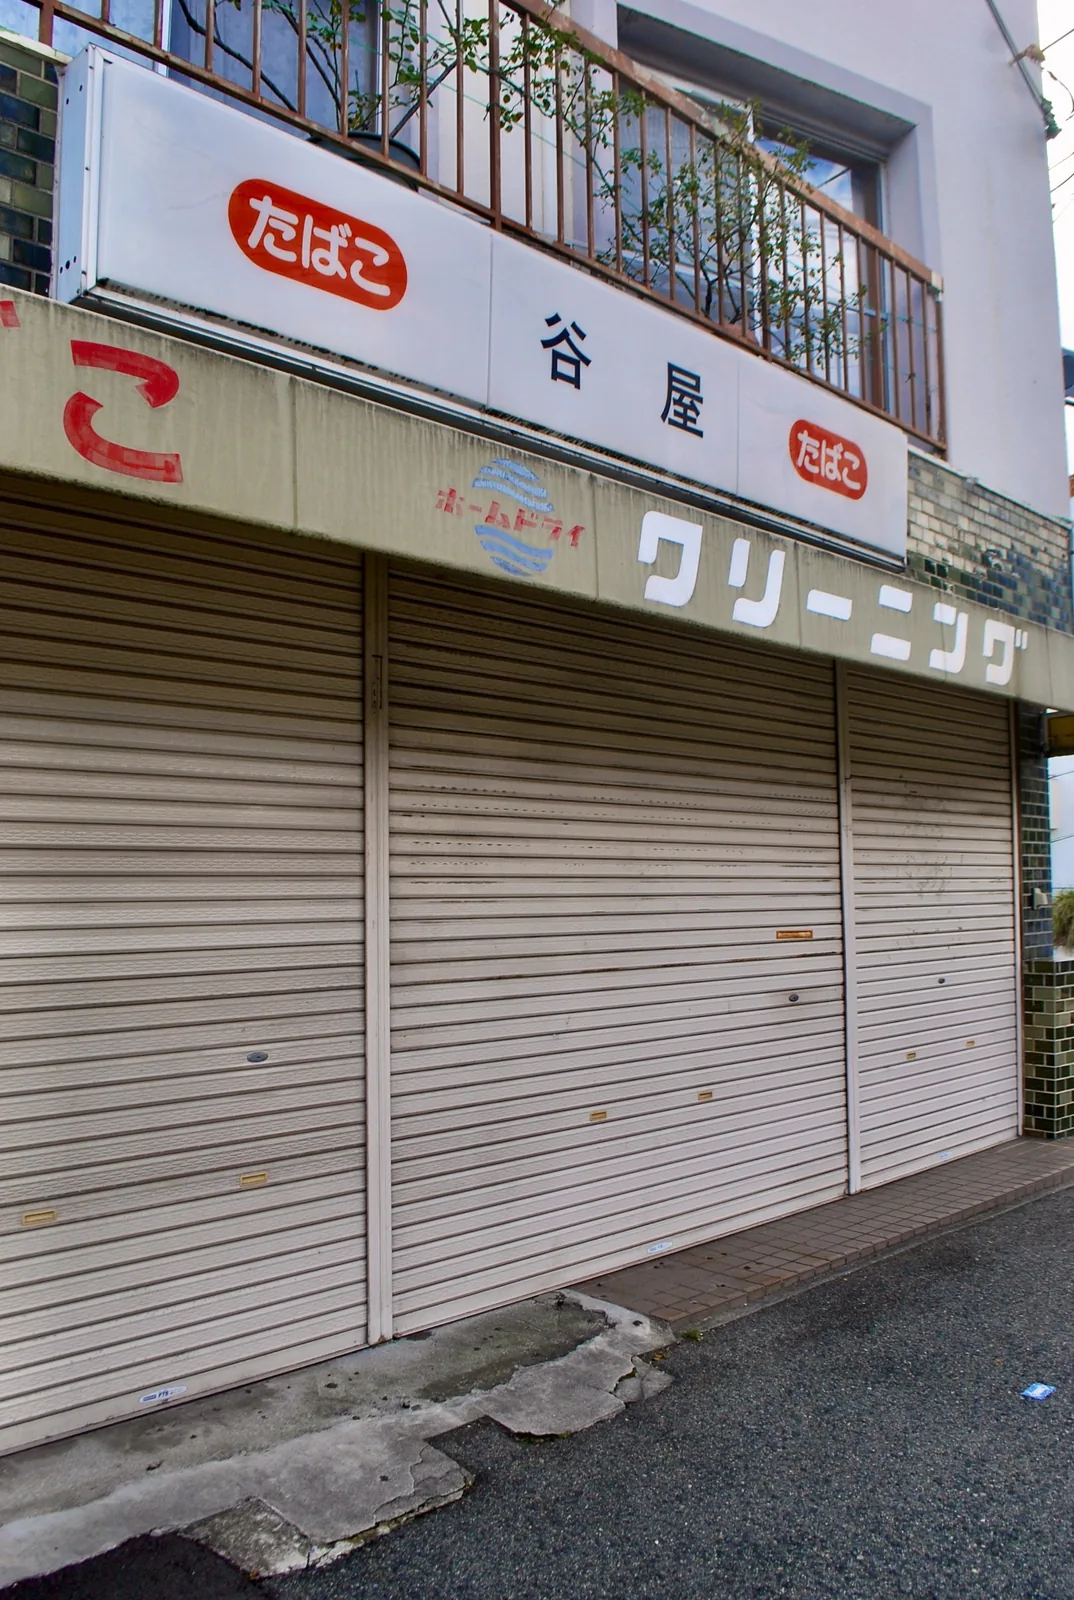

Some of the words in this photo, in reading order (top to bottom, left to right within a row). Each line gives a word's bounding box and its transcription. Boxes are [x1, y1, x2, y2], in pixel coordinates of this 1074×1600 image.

[248, 195, 391, 297] たばこ
[541, 313, 704, 438] 谷屋
[797, 430, 861, 492] たばこ
[435, 488, 586, 548] ホームドライ
[638, 511, 1028, 686] クリーニング
